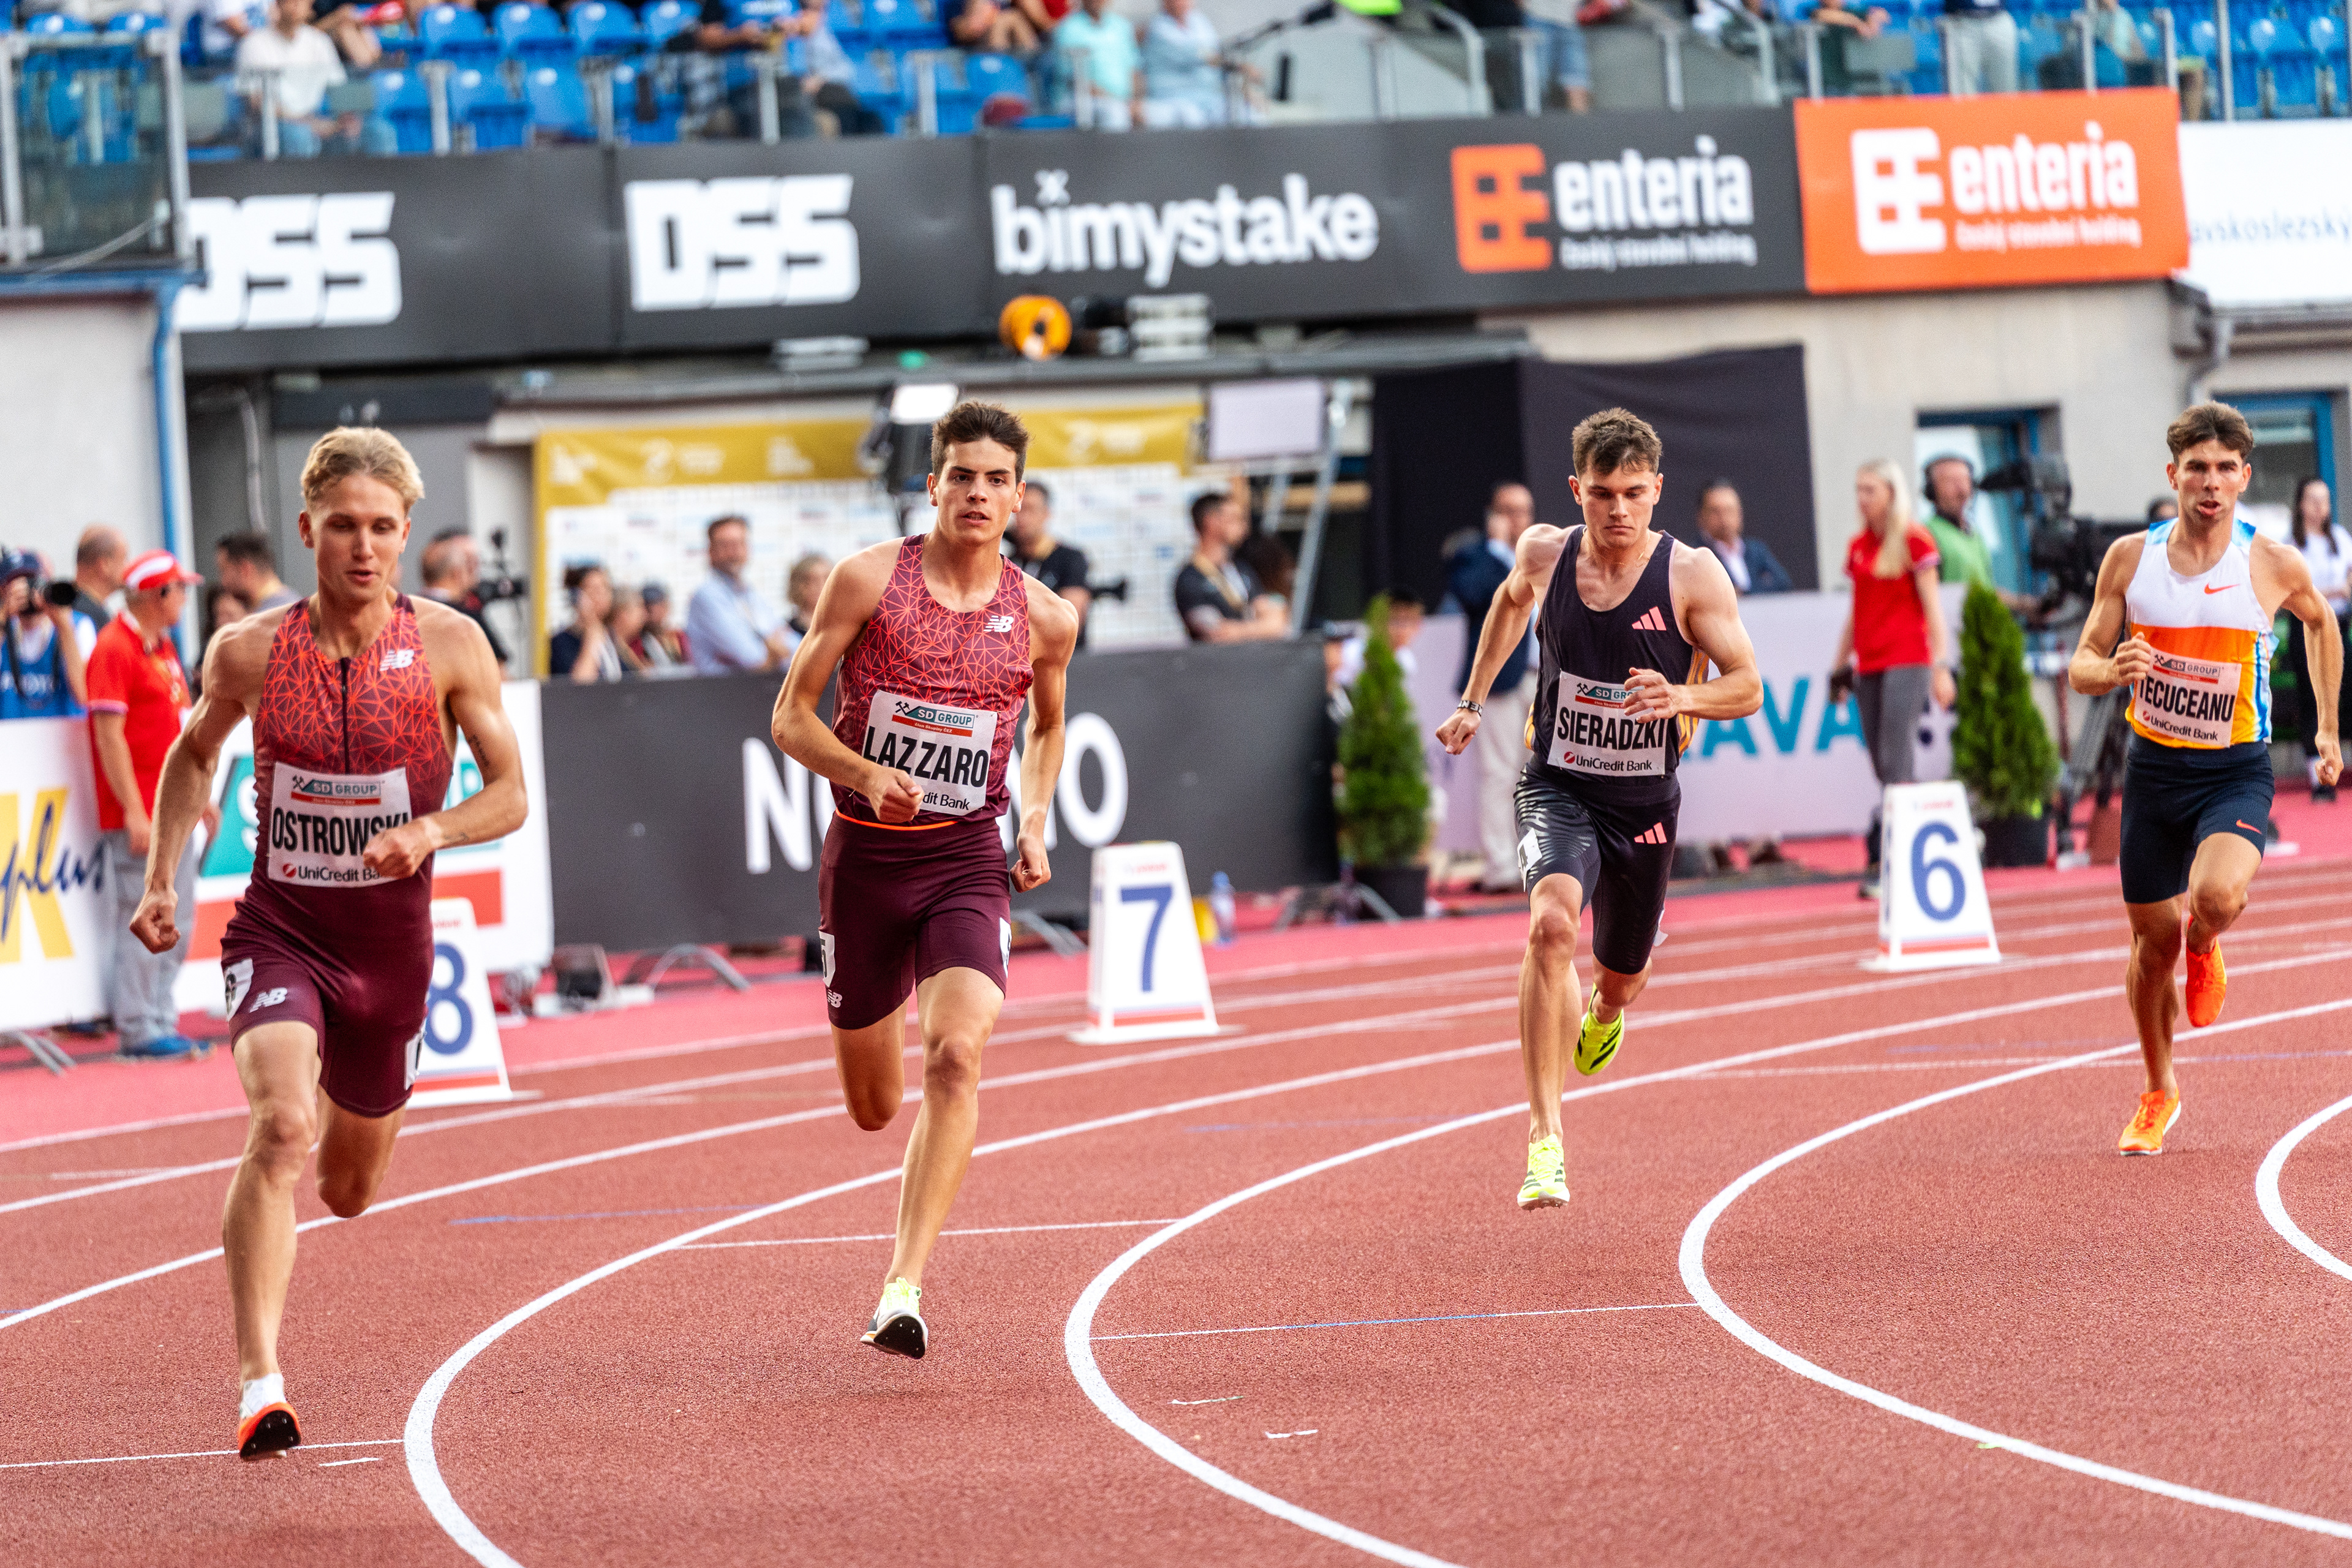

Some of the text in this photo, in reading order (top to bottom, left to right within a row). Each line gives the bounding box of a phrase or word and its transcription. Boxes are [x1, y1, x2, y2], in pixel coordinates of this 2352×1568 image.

[1553, 134, 1755, 232] enteria
[1949, 120, 2139, 214] enteria
[624, 174, 861, 311] DSS
[990, 170, 1379, 287] bimystake
[2187, 664, 2217, 675] GROUP
[1595, 688, 1610, 698] SD
[918, 708, 973, 726] SD GROUP
[1557, 706, 1665, 751] SIERADZKI
[2150, 715, 2218, 741] UniCredit Bank
[863, 725, 989, 788] LAZZARO
[1576, 754, 1653, 772] UniCredit Bank
[334, 784, 377, 796] GROUP
[940, 794, 970, 811] Bank
[298, 865, 359, 882] UniCredit
[1912, 820, 1966, 922] 6
[1120, 886, 1173, 992] 7
[424, 941, 472, 1055] 8
